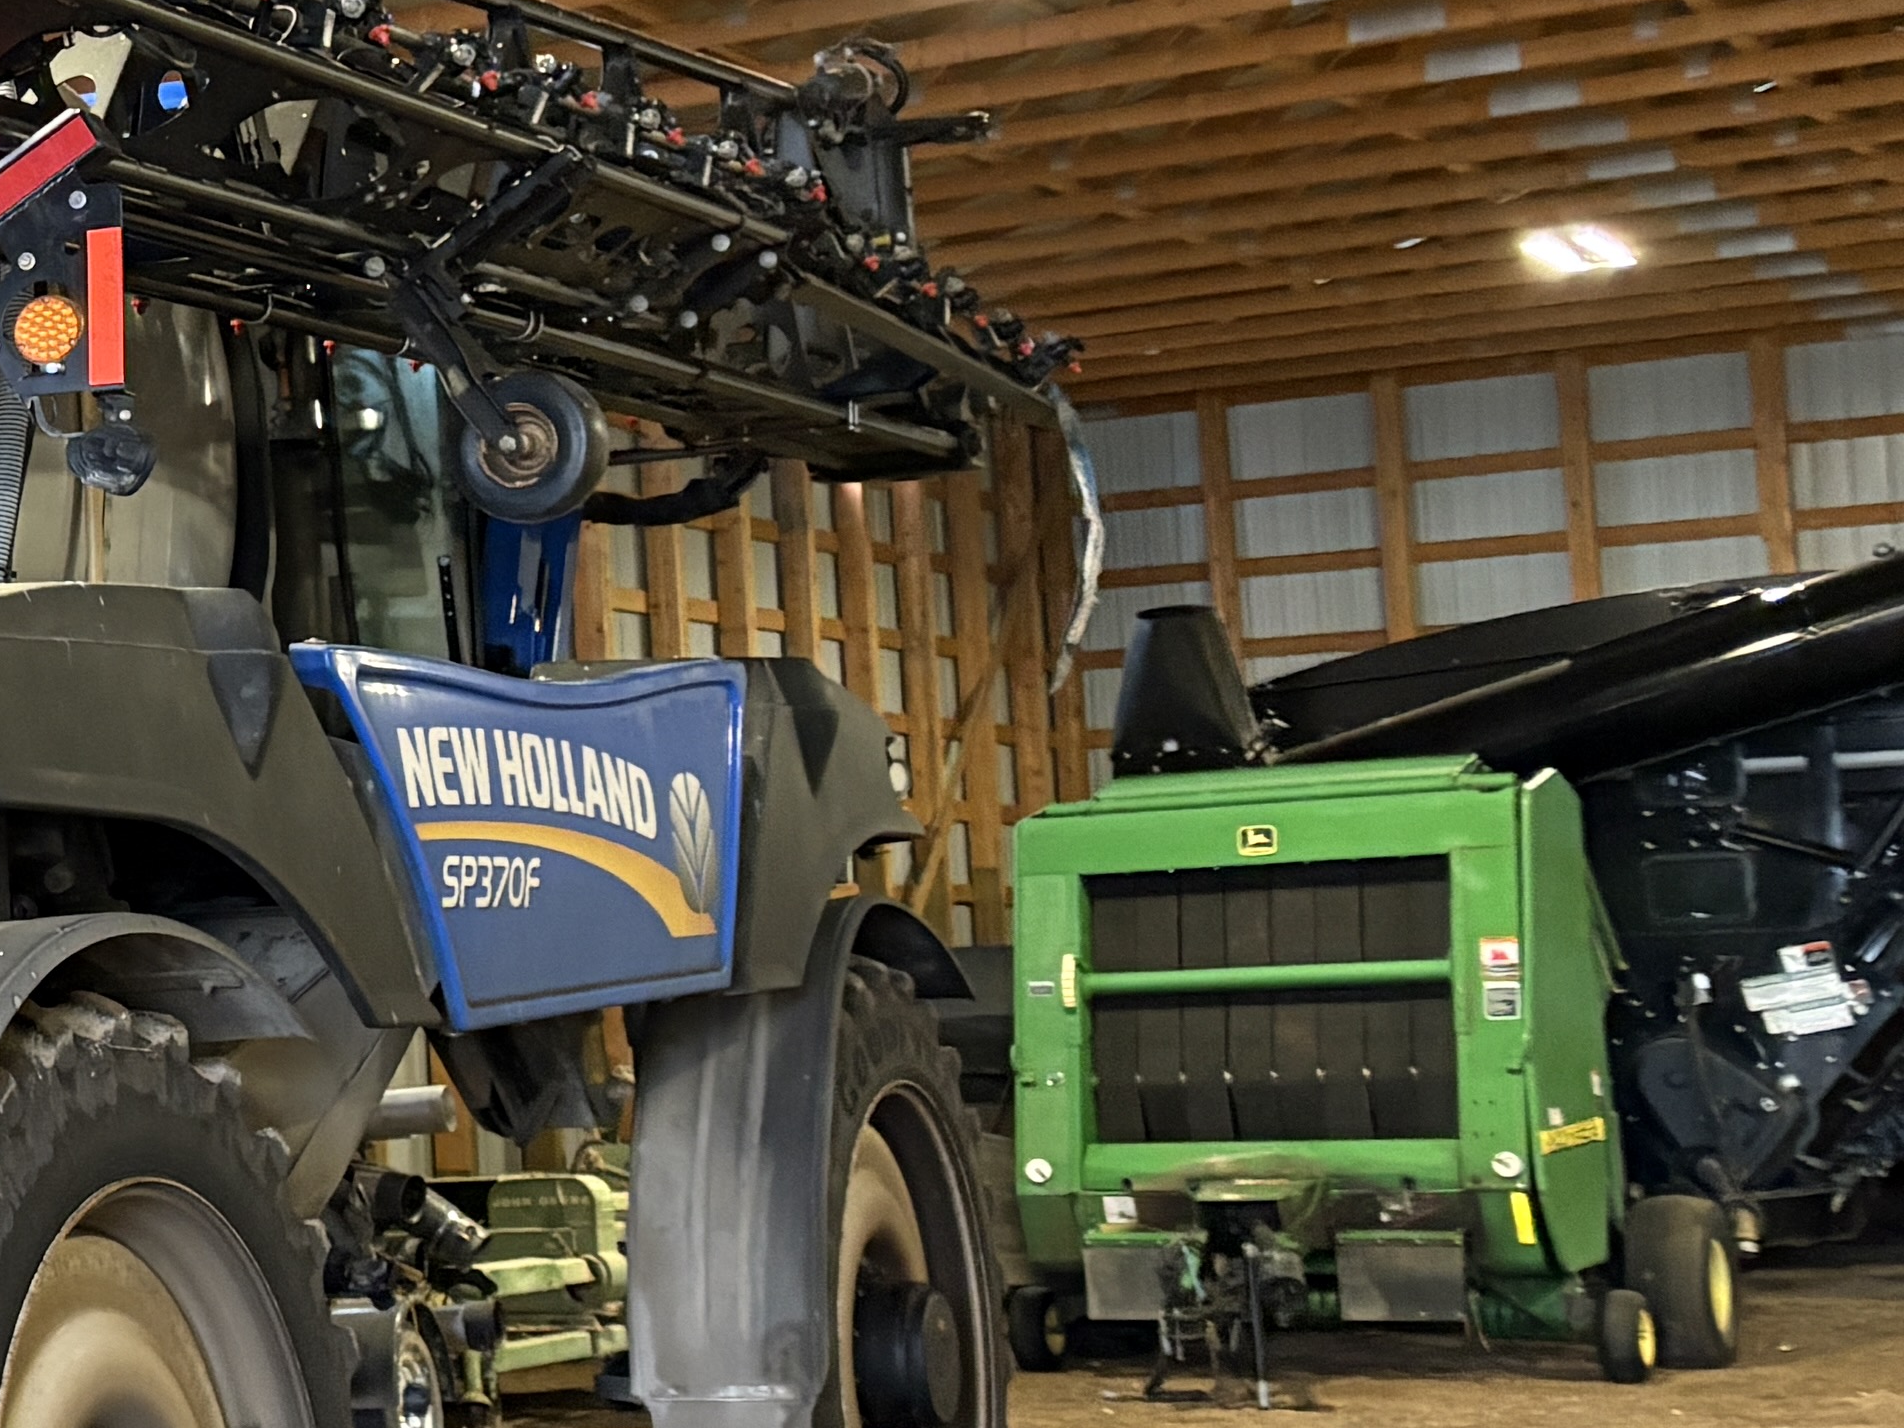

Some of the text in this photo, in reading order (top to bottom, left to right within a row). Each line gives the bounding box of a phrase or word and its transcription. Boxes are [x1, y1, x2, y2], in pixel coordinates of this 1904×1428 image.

[397, 727, 657, 839] NEW HOLLAND
[442, 855, 541, 908] SP370F
